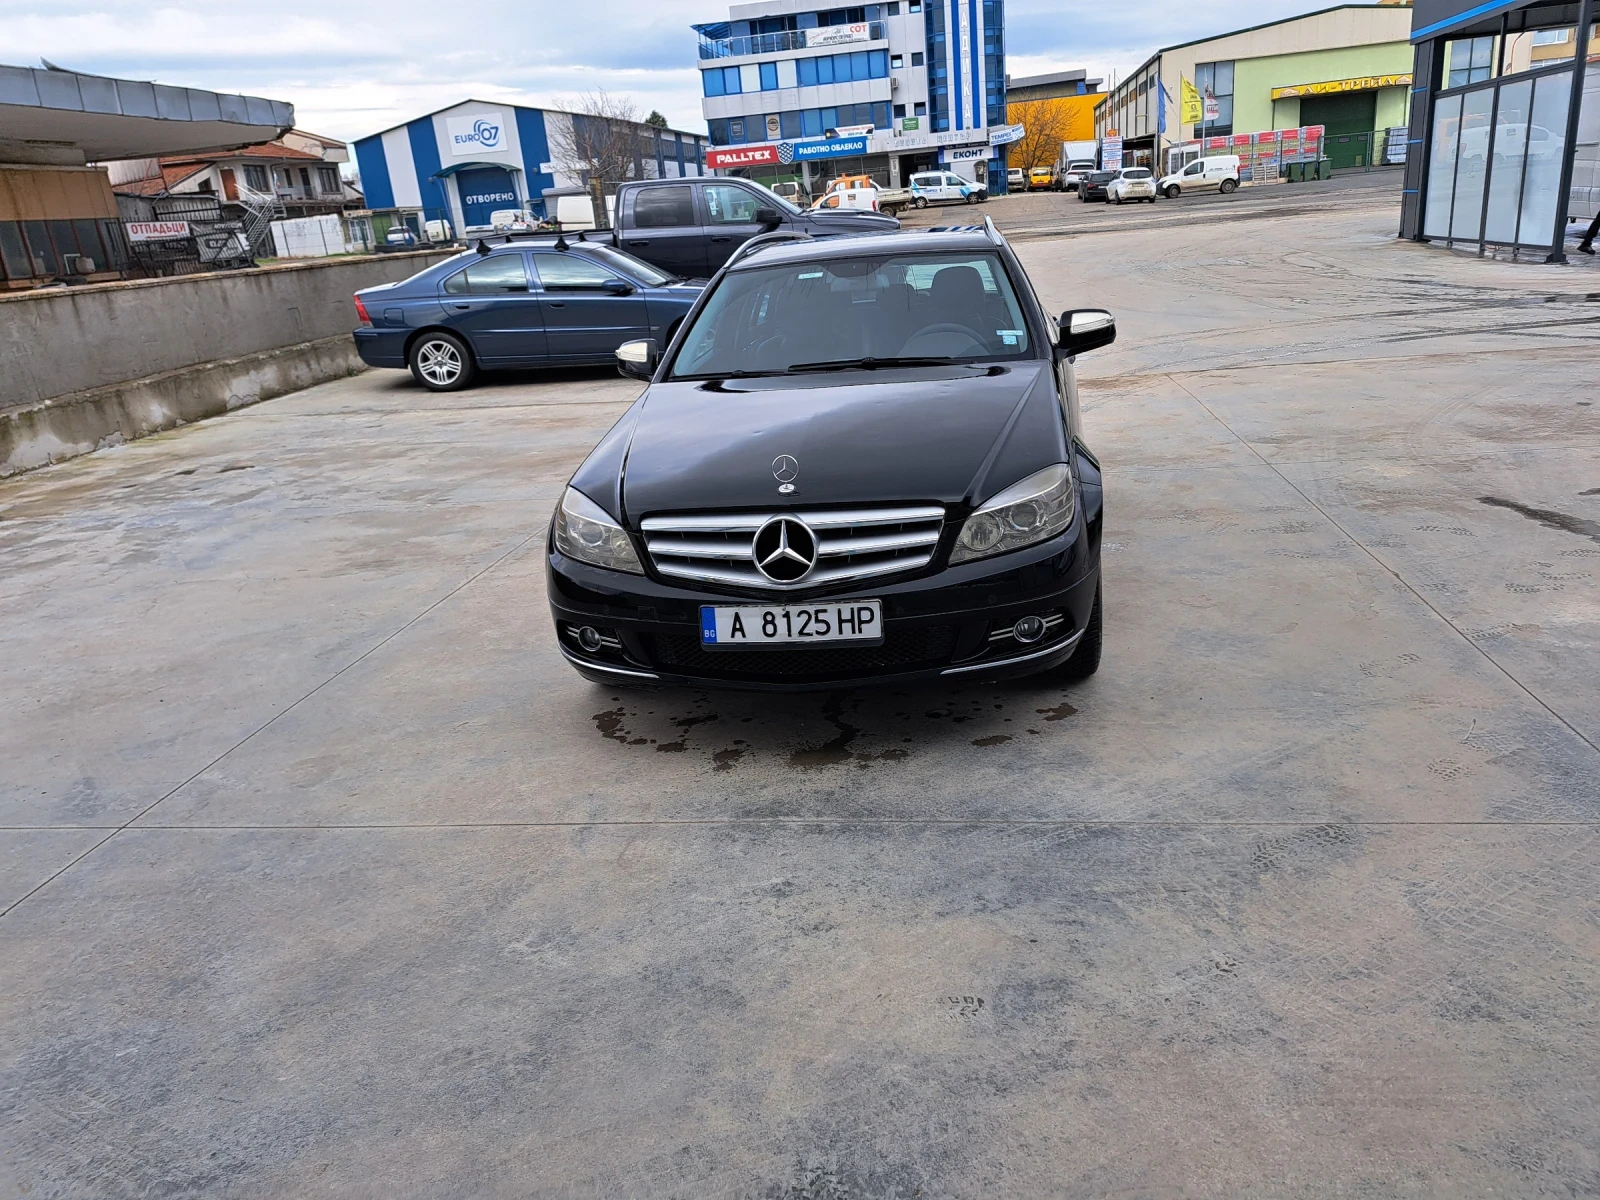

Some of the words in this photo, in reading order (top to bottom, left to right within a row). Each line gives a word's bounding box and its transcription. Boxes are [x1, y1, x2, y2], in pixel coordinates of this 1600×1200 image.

[799, 145, 829, 155] РАБОТНО
[831, 141, 863, 151] ОБЛЕКЛО
[953, 149, 984, 159] ЕКОНТ
[716, 150, 771, 164] PALLTEX
[466, 192, 514, 204] ОТВОРЕНО
[131, 222, 186, 235] ОТПАДЪЦИ
[730, 612, 746, 638] A
[762, 609, 831, 638] 8125
[837, 606, 874, 635] HP
[704, 629, 716, 638] BG
